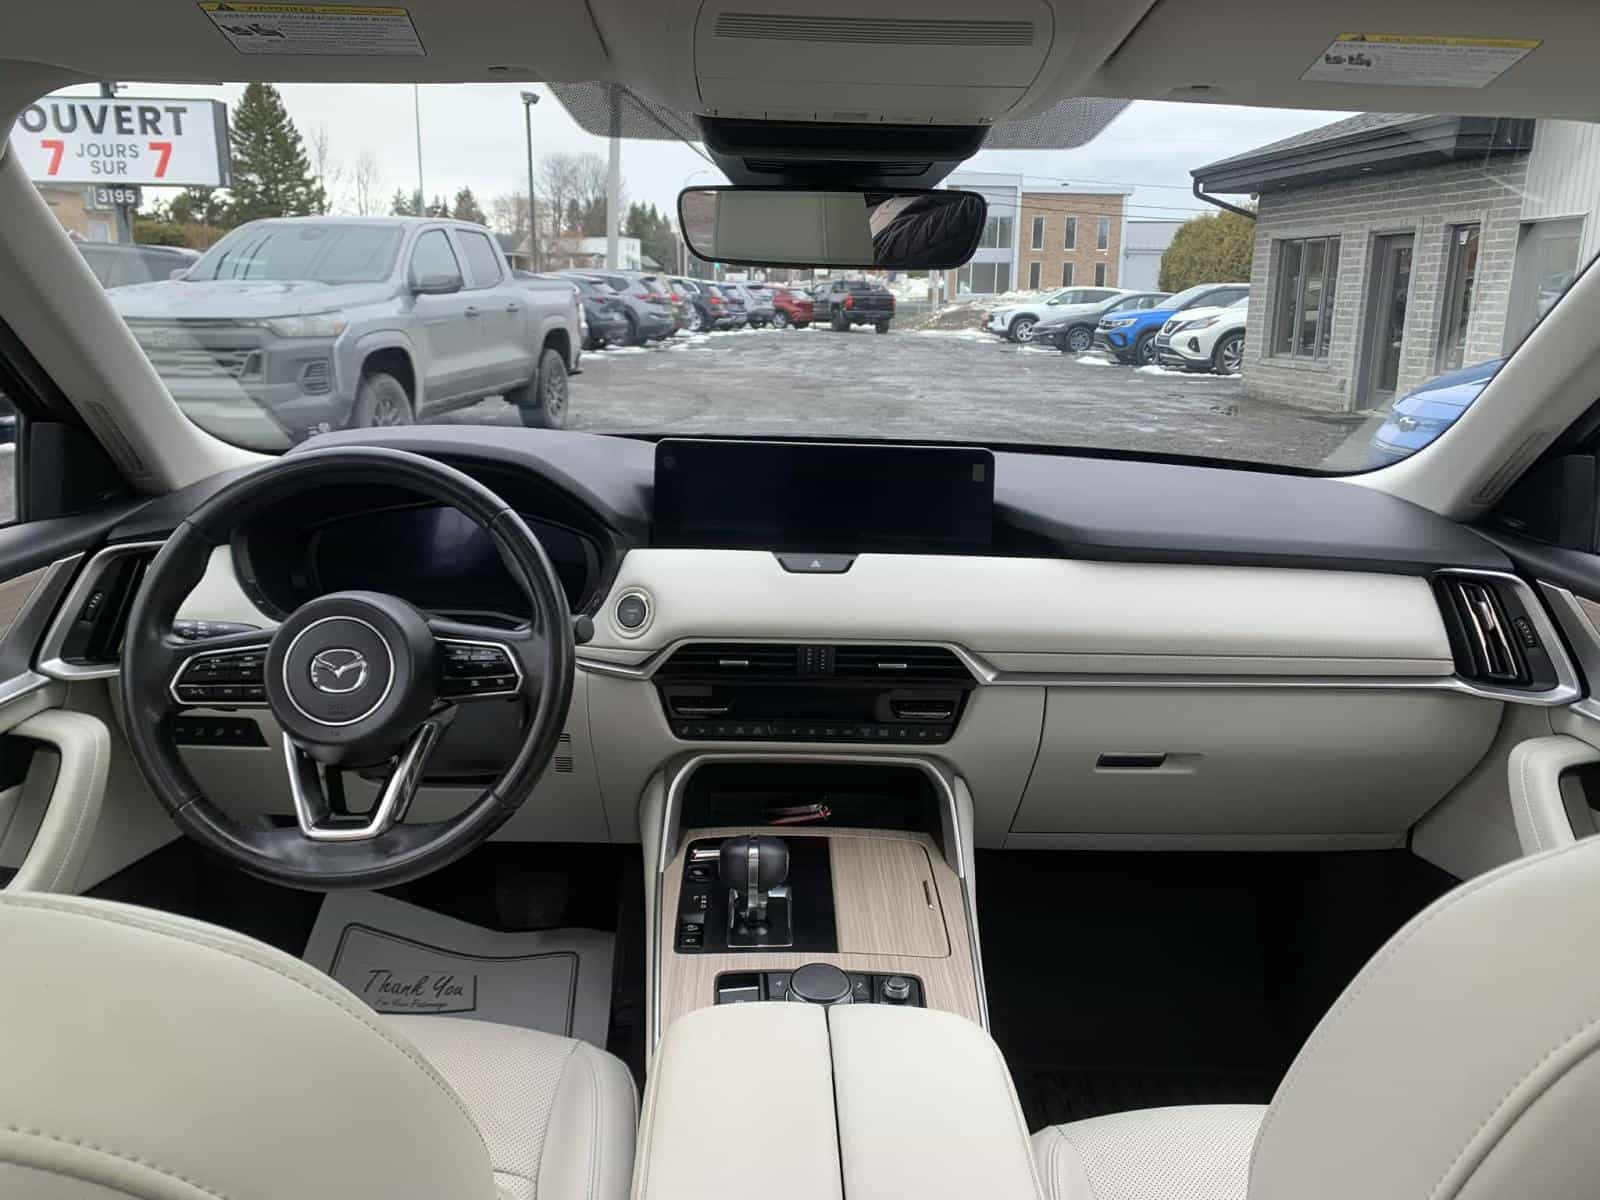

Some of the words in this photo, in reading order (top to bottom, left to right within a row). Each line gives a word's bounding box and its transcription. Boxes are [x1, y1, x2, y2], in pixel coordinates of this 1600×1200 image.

[20, 104, 187, 135] OUVERT
[41, 140, 64, 175] 7
[76, 143, 139, 158] JOURS
[148, 142, 172, 177] 7
[91, 160, 127, 175] SUR
[99, 189, 136, 204] 3195
[363, 969, 430, 996] Thank
[433, 975, 464, 998] You
